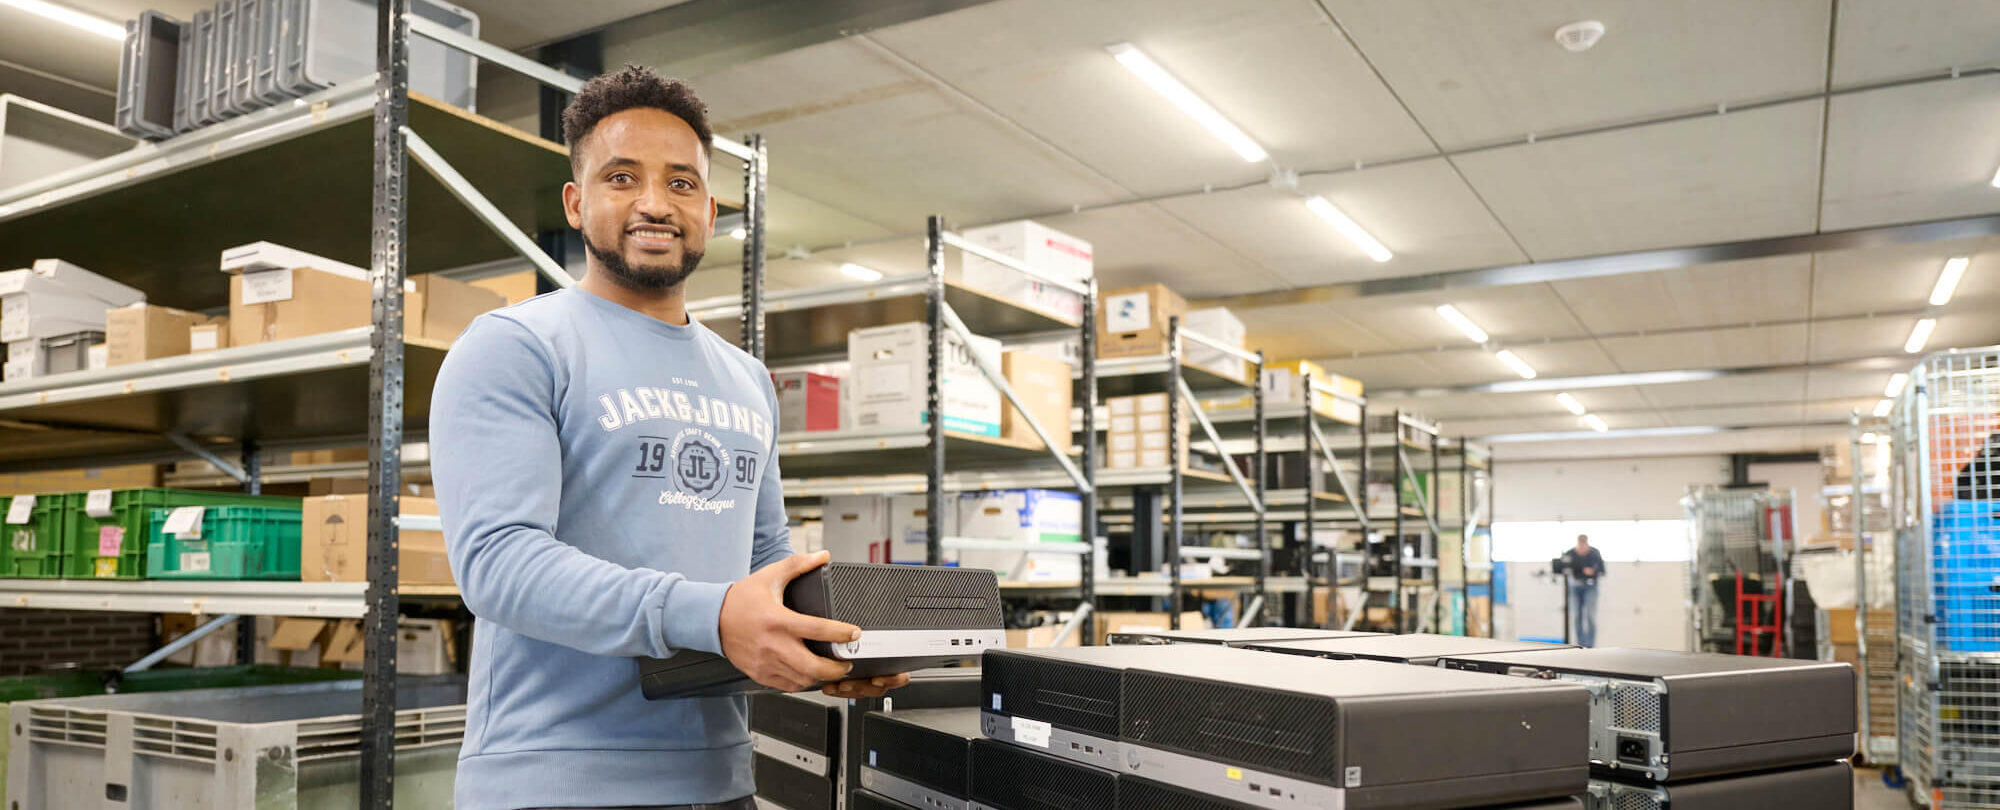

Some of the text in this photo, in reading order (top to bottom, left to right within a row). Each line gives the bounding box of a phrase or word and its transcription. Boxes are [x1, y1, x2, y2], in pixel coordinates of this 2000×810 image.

[636, 442, 666, 472] 19
[735, 455, 757, 484] 90
[658, 490, 735, 515] College League
